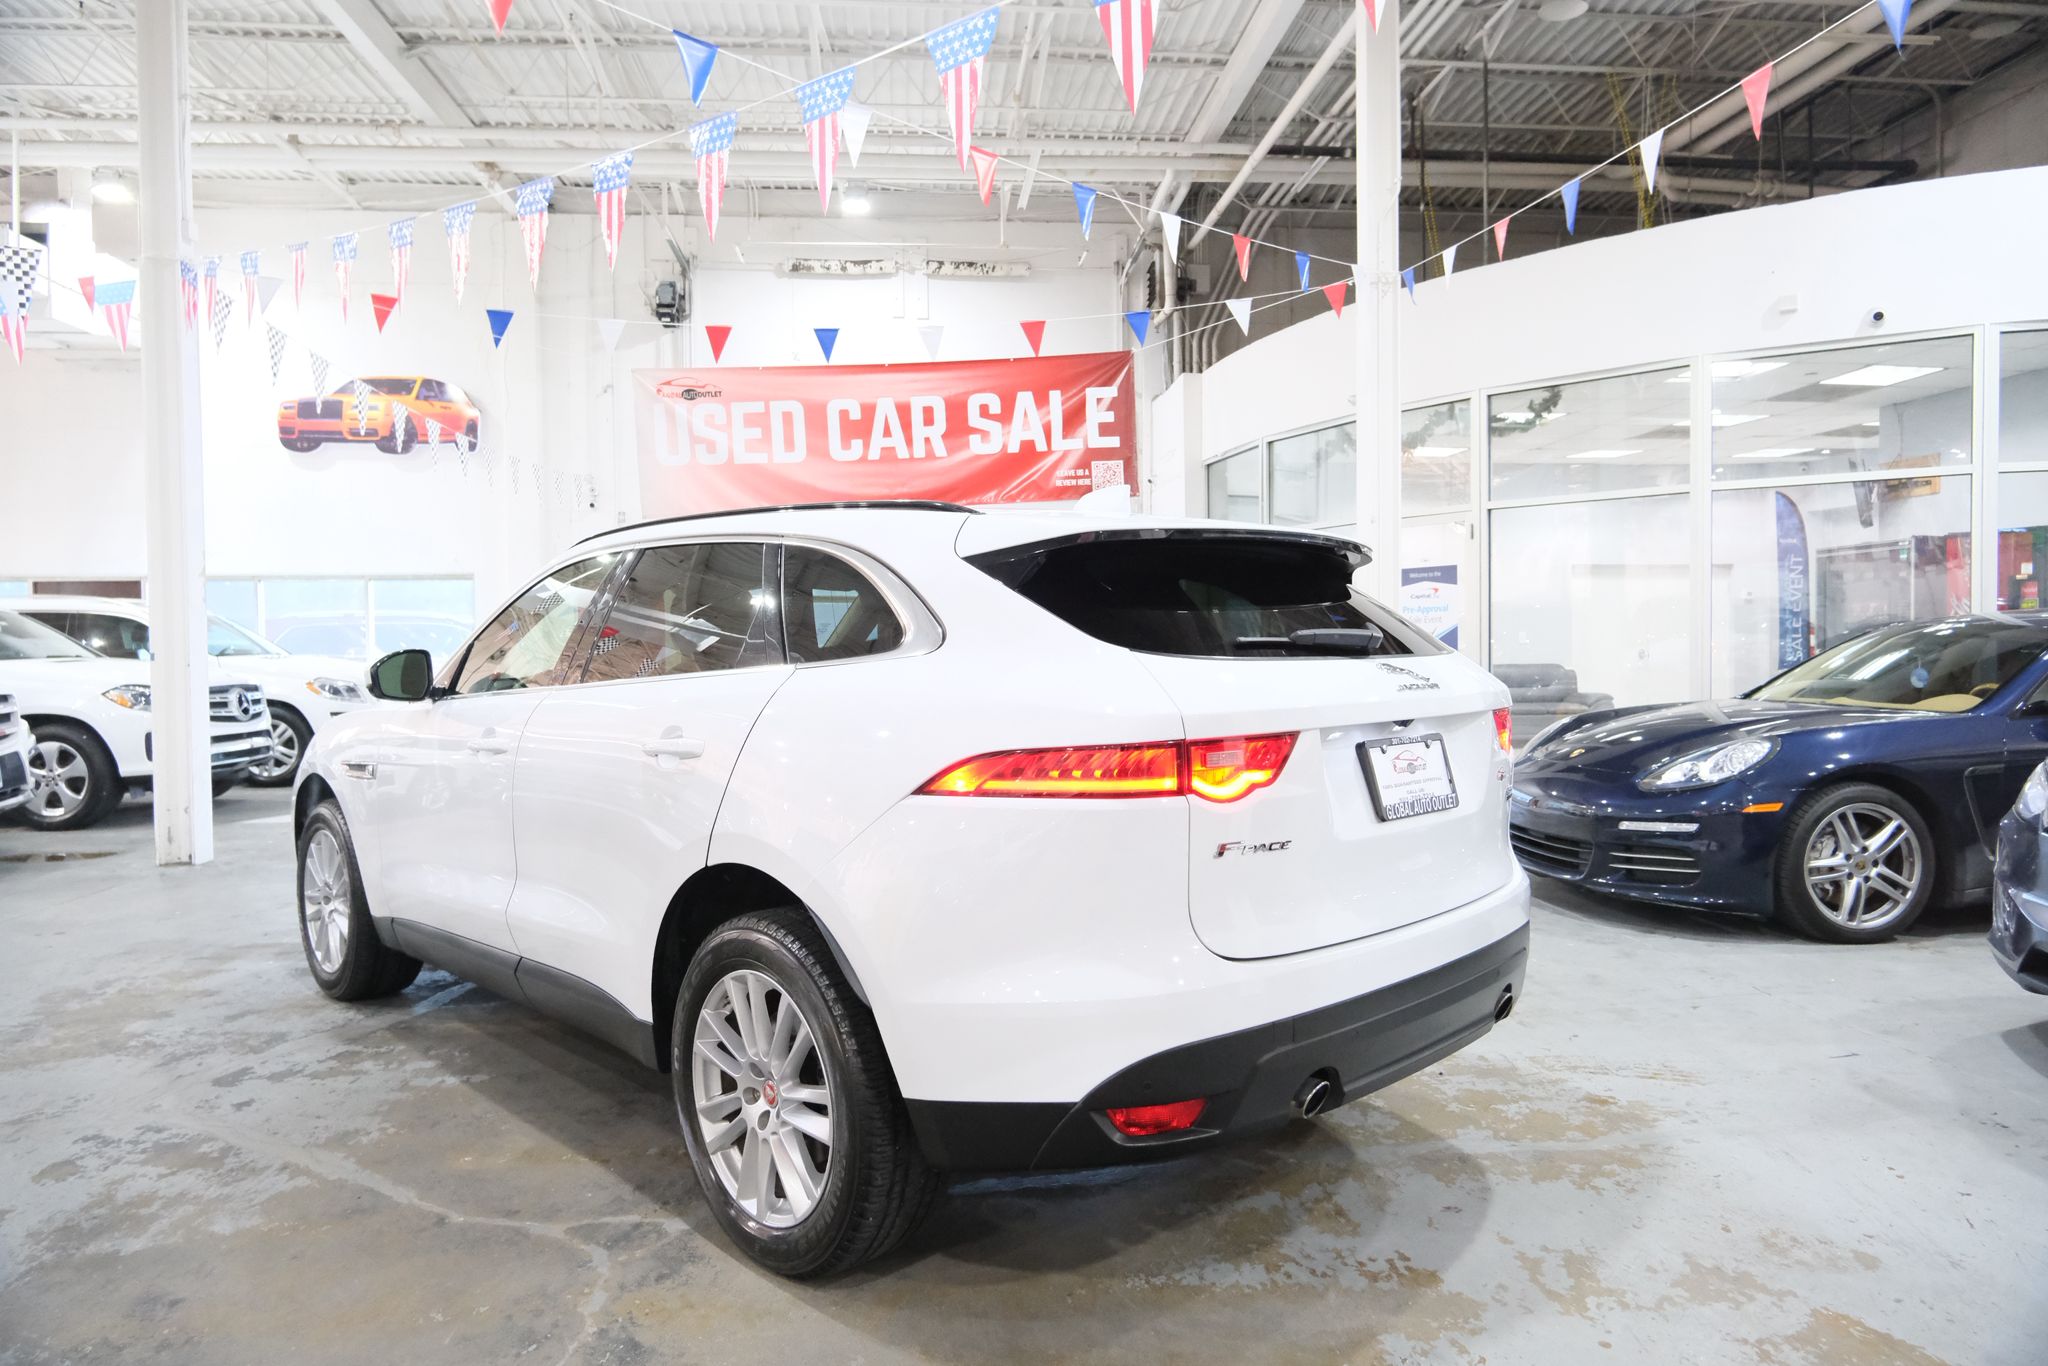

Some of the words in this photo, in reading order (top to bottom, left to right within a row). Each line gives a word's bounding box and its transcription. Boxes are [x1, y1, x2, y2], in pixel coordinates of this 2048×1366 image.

[654, 400, 807, 467] USED
[828, 396, 947, 462] CAR
[967, 386, 1122, 455] SALE
[1055, 479, 1077, 487] REVIEW
[1078, 478, 1092, 486] HERE
[1790, 553, 1804, 612] EVENT
[1402, 603, 1449, 615] Pre-Approval
[1791, 616, 1804, 662] SALE
[1386, 802, 1414, 820] GLOBAL
[1414, 797, 1432, 814] AUTO
[1432, 793, 1456, 810] OUTLET
